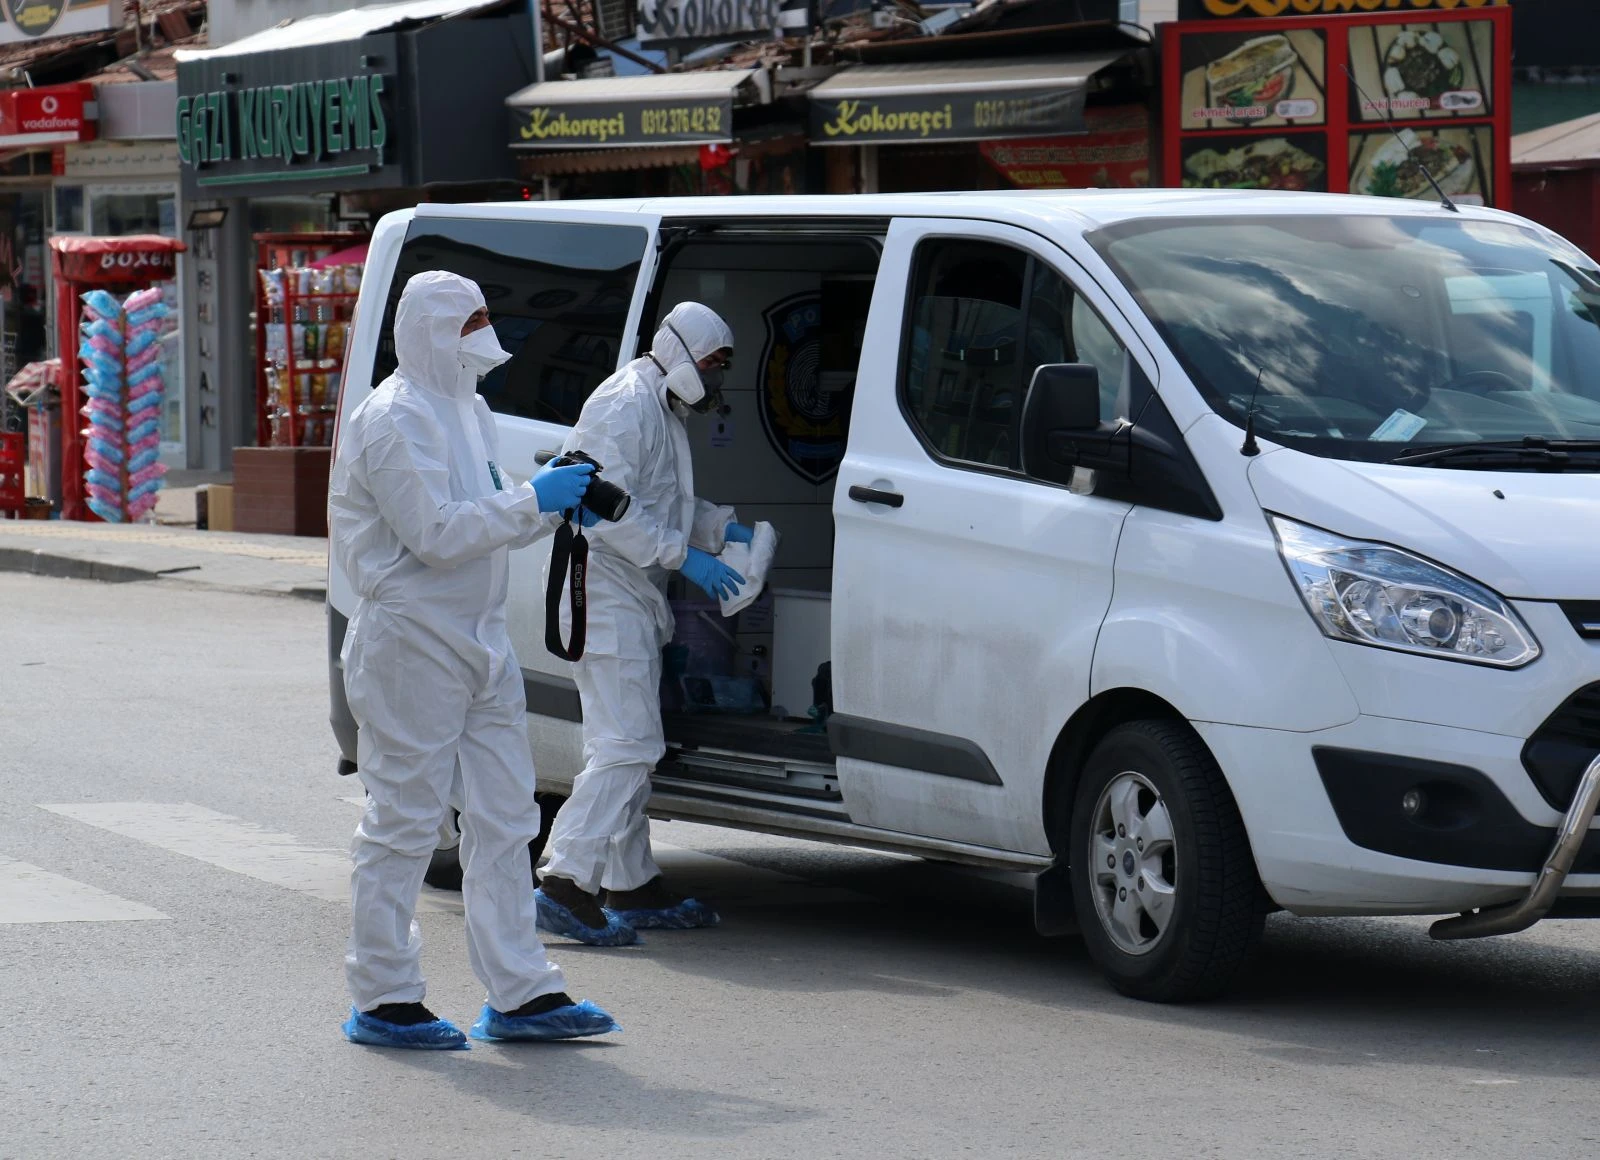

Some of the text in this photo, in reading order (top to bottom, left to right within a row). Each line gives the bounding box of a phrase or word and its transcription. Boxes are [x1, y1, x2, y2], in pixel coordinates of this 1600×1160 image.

[22, 116, 80, 129] vodafone
[520, 106, 721, 142] Kokoreçci 0312 376 42 52
[824, 100, 952, 136] Kokoreçci
[1192, 104, 1233, 118] ekmek
[574, 563, 584, 589] EOS
